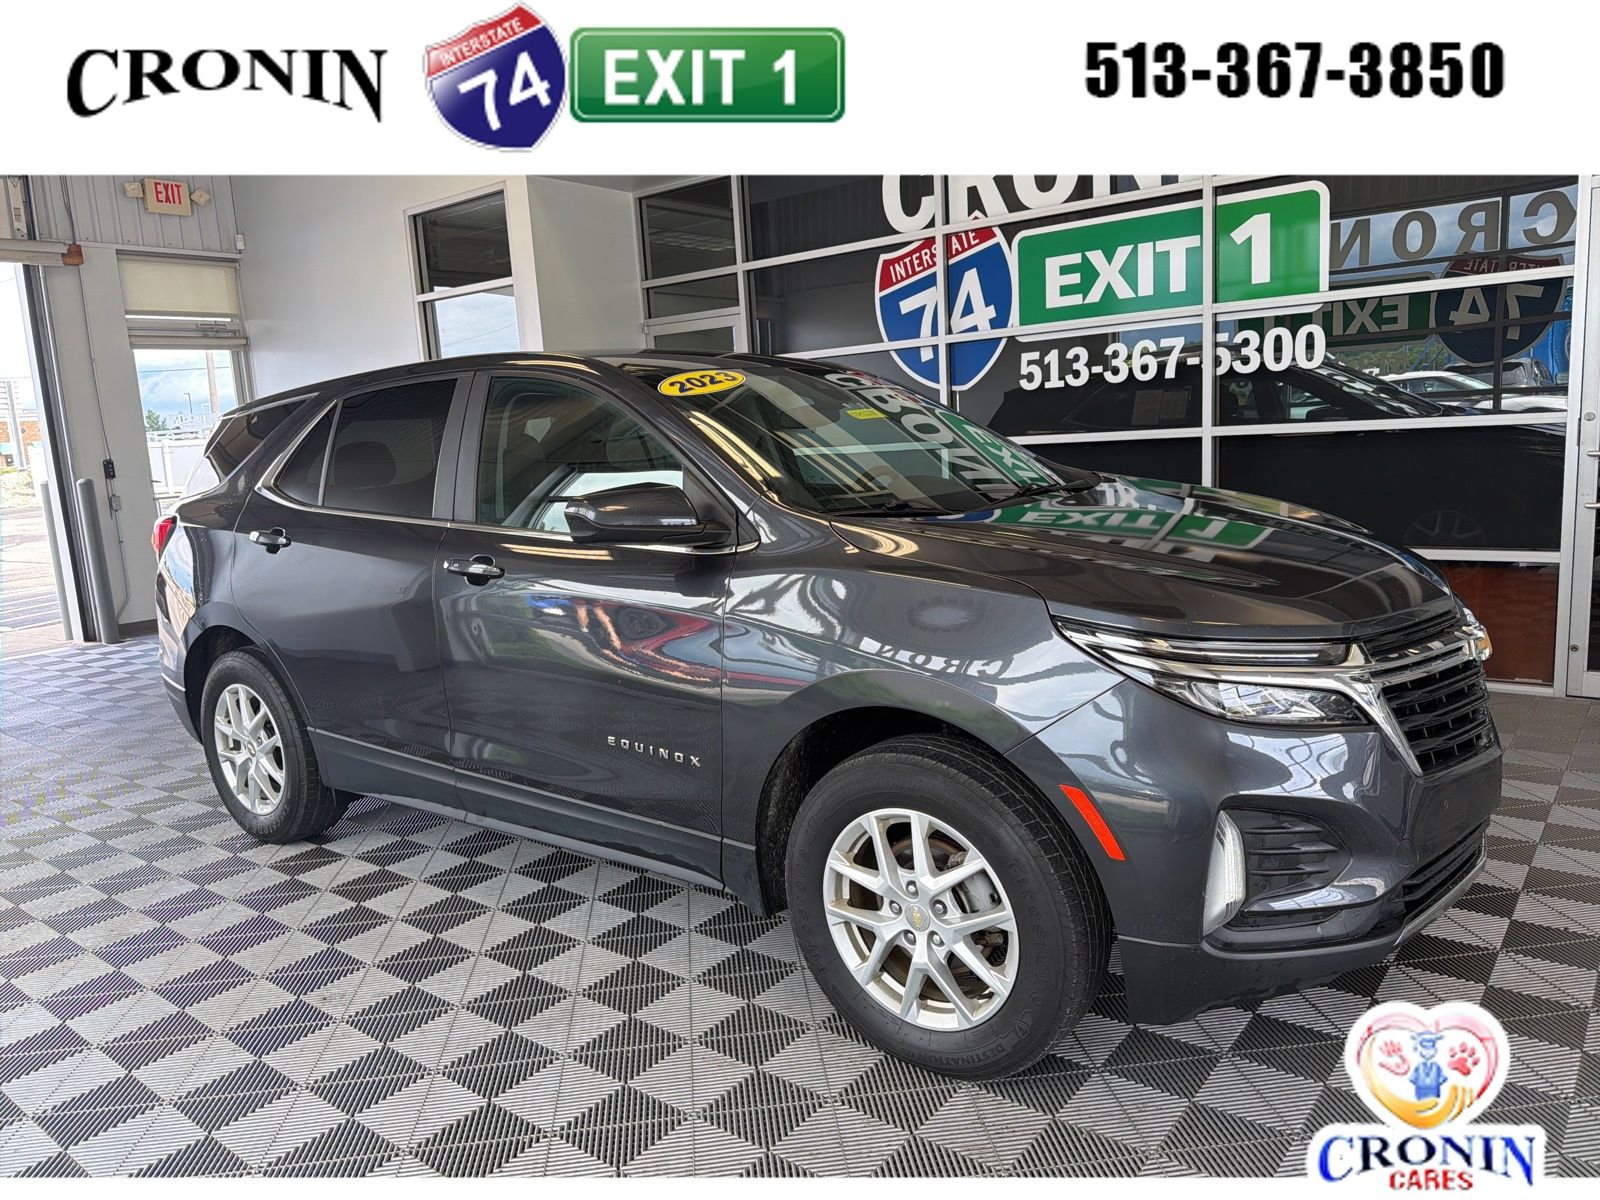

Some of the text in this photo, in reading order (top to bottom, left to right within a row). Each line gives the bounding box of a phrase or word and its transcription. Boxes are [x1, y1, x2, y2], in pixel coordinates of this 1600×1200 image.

[153, 181, 183, 205] EXIT
[889, 229, 981, 283] INTERSATE
[1045, 212, 1271, 309] EXIT 1
[898, 267, 997, 363] 74
[668, 372, 738, 394] 2023
[607, 735, 702, 768] EQUINOX
